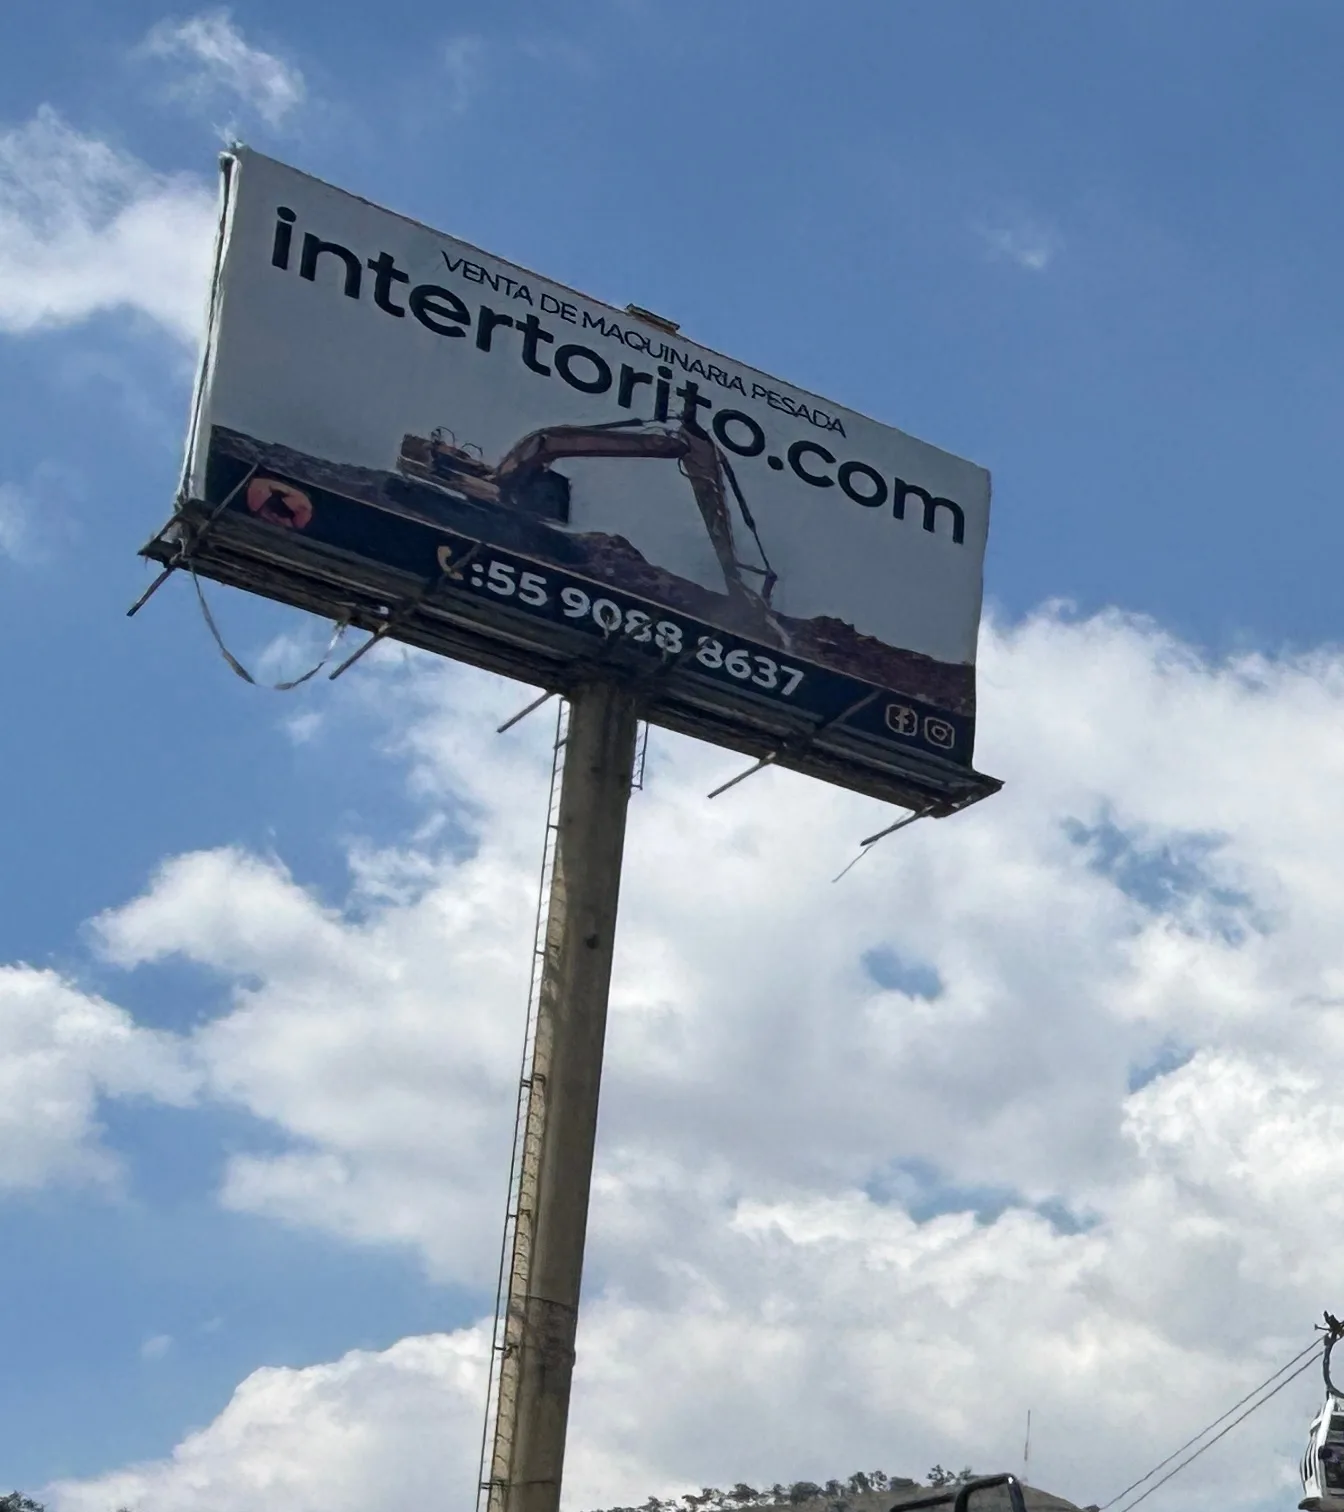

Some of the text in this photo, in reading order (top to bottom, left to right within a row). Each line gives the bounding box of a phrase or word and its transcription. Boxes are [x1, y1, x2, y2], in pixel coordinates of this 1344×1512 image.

[272, 206, 965, 545] intertorito.com
[441, 250, 846, 438] VENTA DE MAQUINARIA PESADA
[695, 635, 804, 696] 8637
